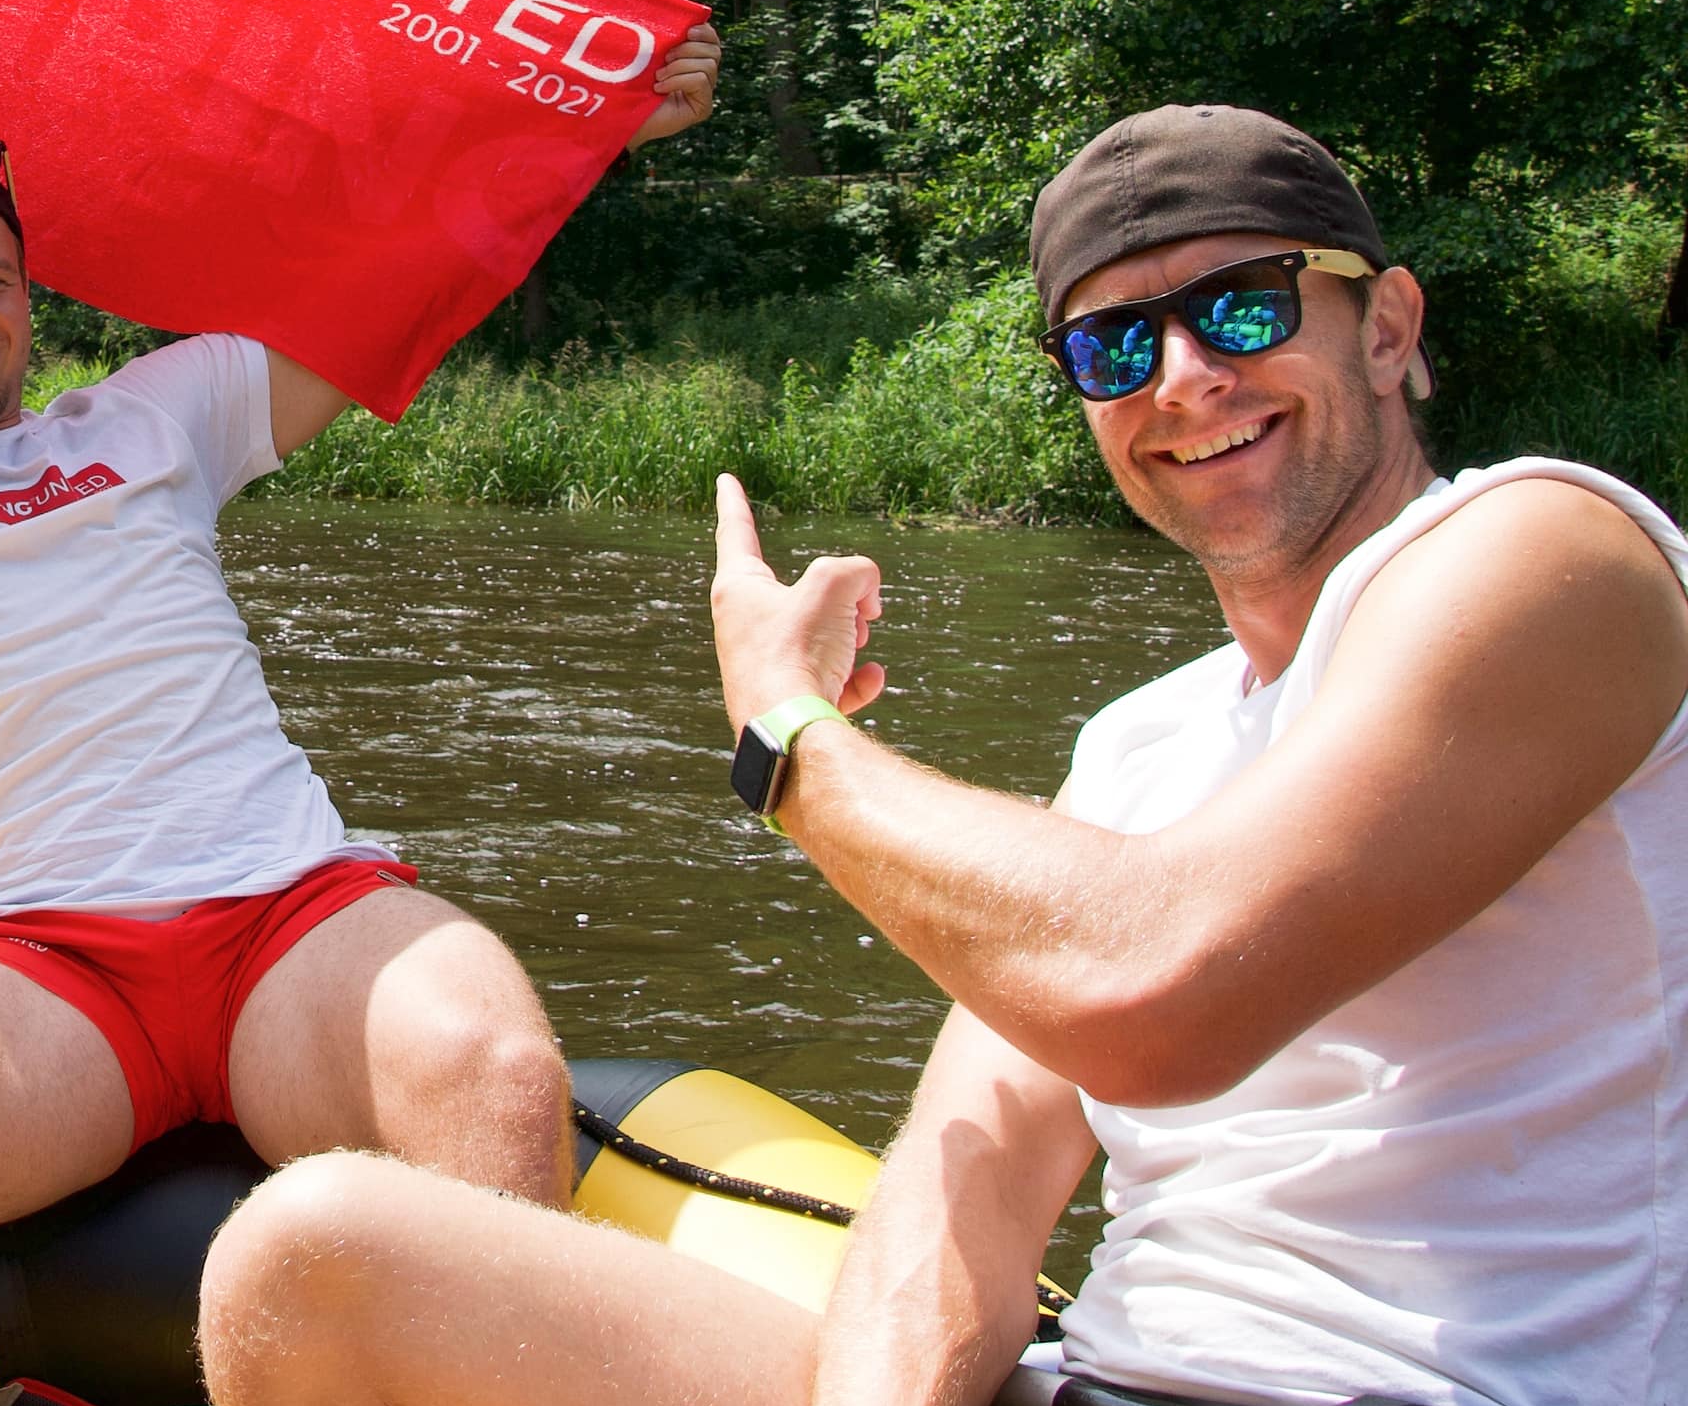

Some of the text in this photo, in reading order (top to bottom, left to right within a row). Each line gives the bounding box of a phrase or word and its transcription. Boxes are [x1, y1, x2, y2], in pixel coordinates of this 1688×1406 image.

[379, 3, 482, 65] 2001
[506, 61, 606, 118] 2021
[36, 474, 108, 506] UNED
